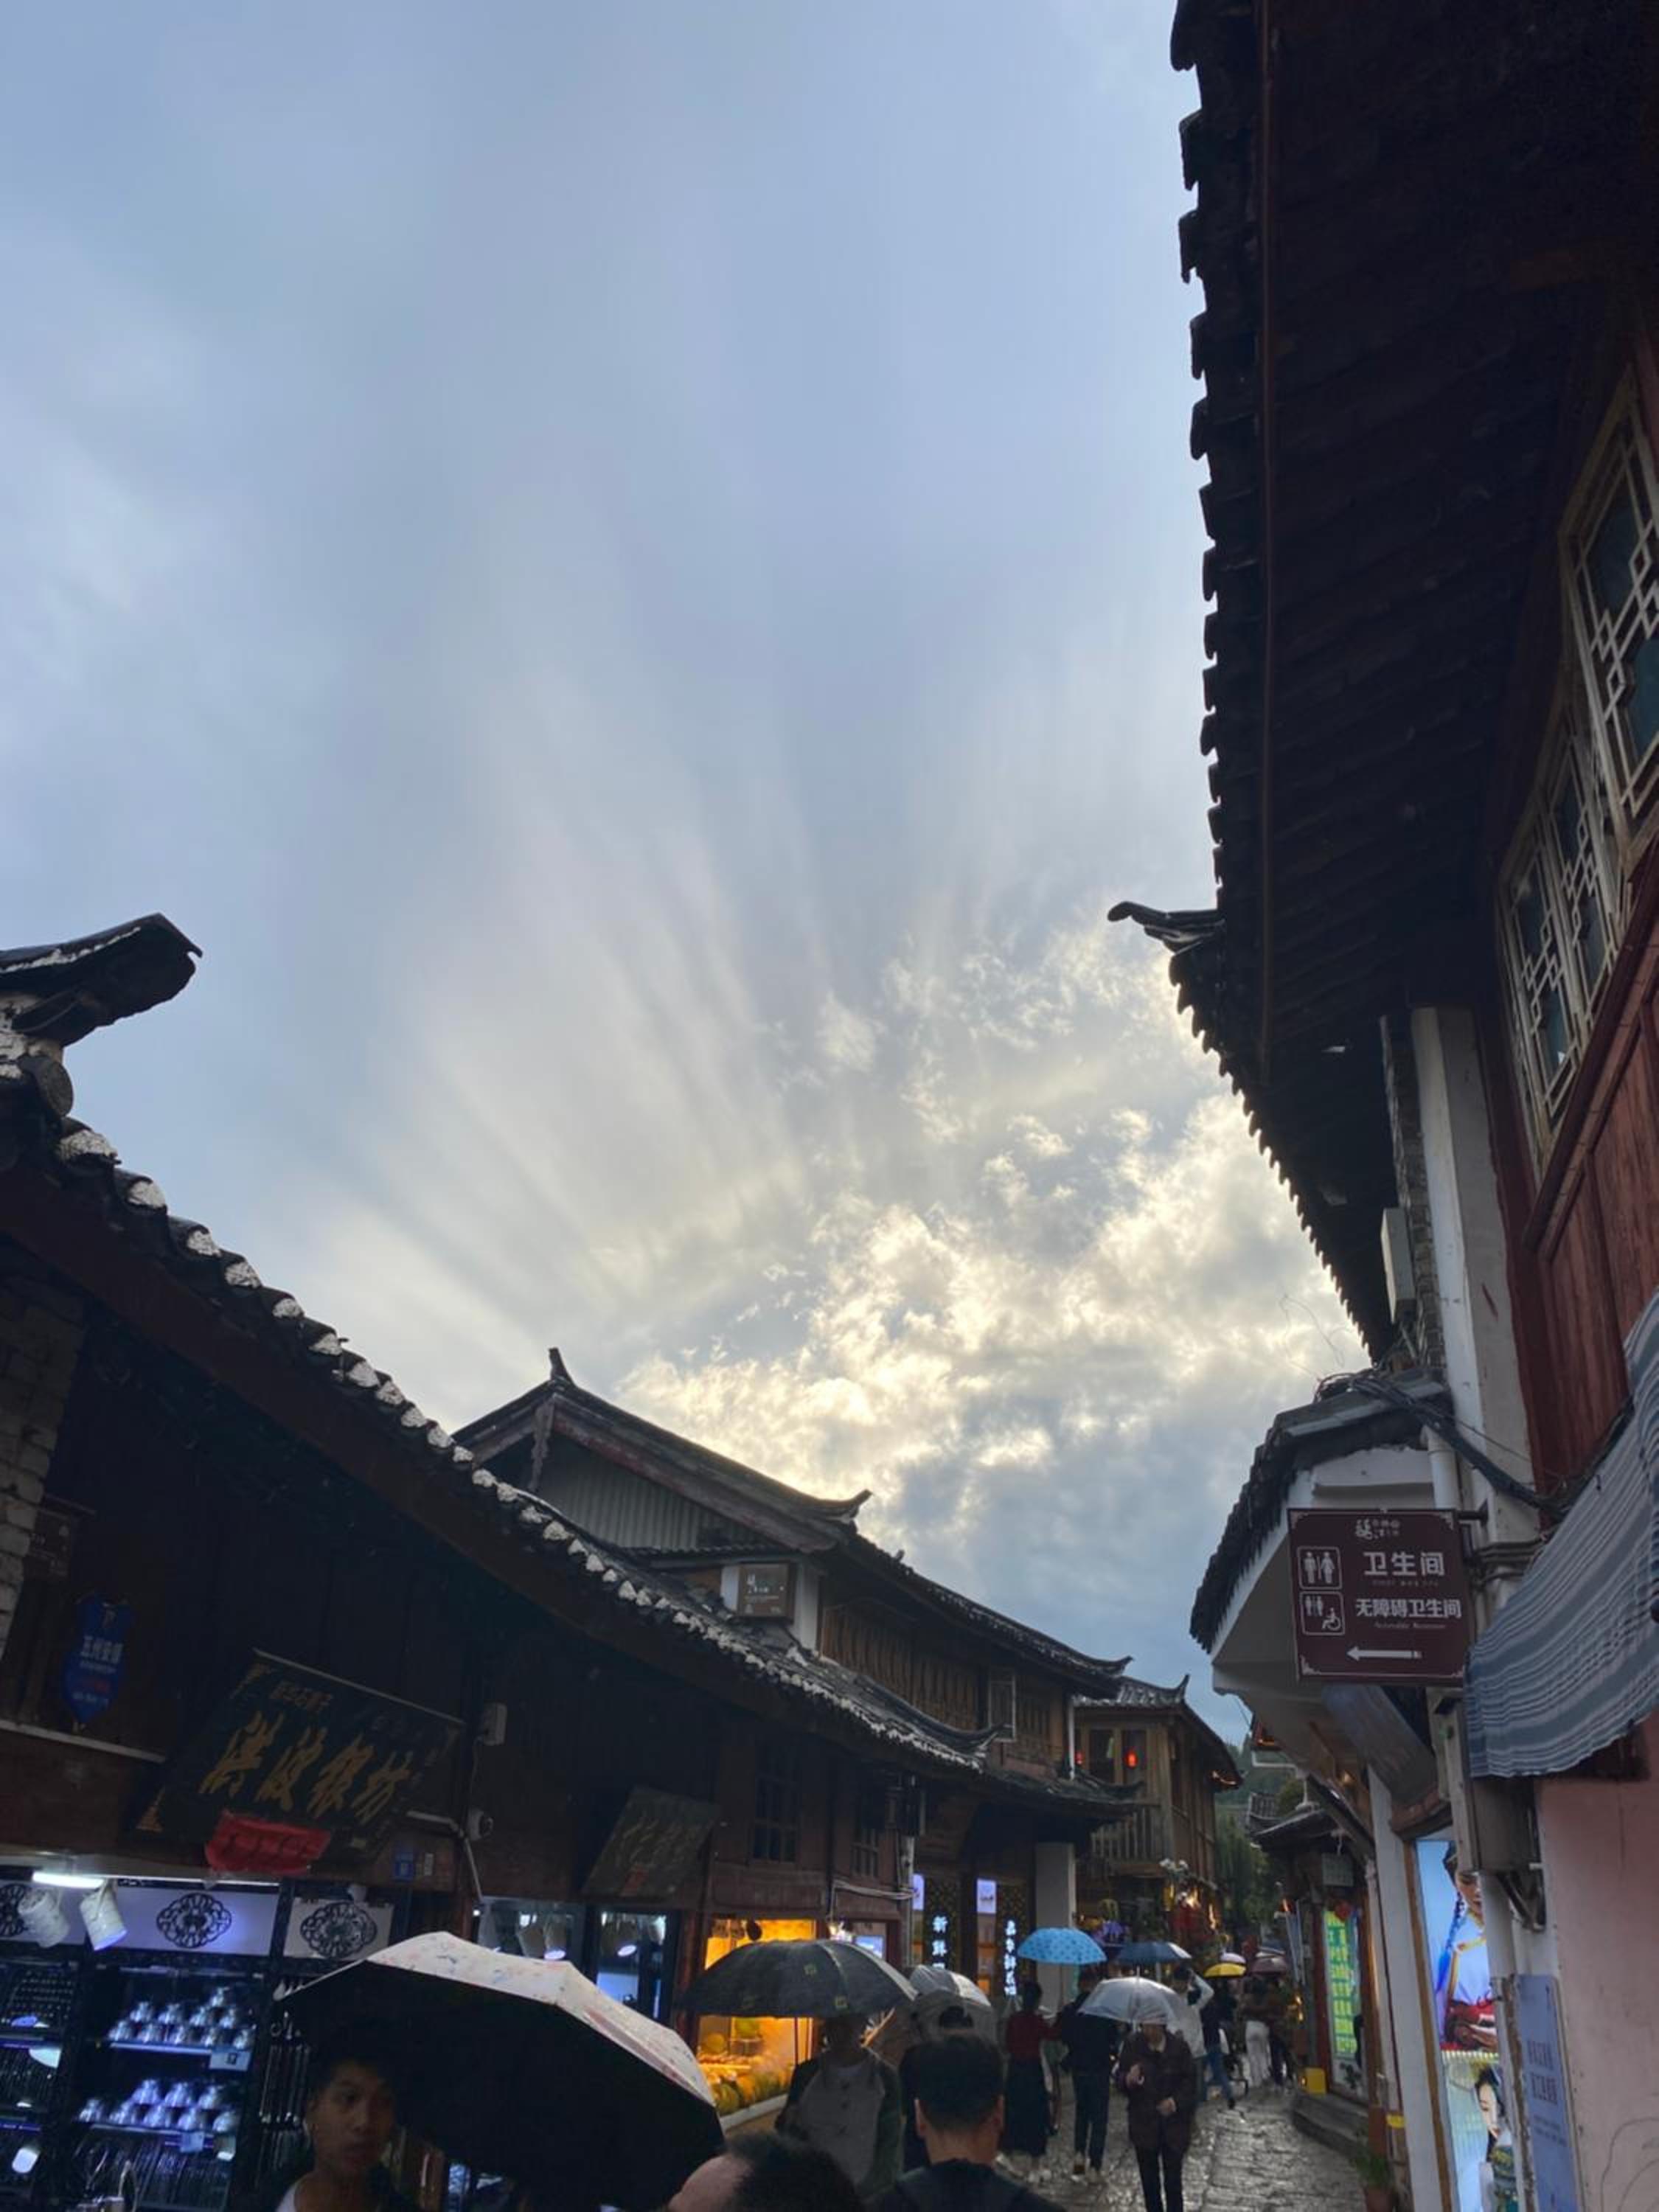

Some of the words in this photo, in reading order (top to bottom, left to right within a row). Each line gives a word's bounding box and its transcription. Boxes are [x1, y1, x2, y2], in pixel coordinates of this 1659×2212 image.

[1363, 1551, 1444, 1576] 卫生间
[1355, 1598, 1462, 1618] 无障碍卫生间
